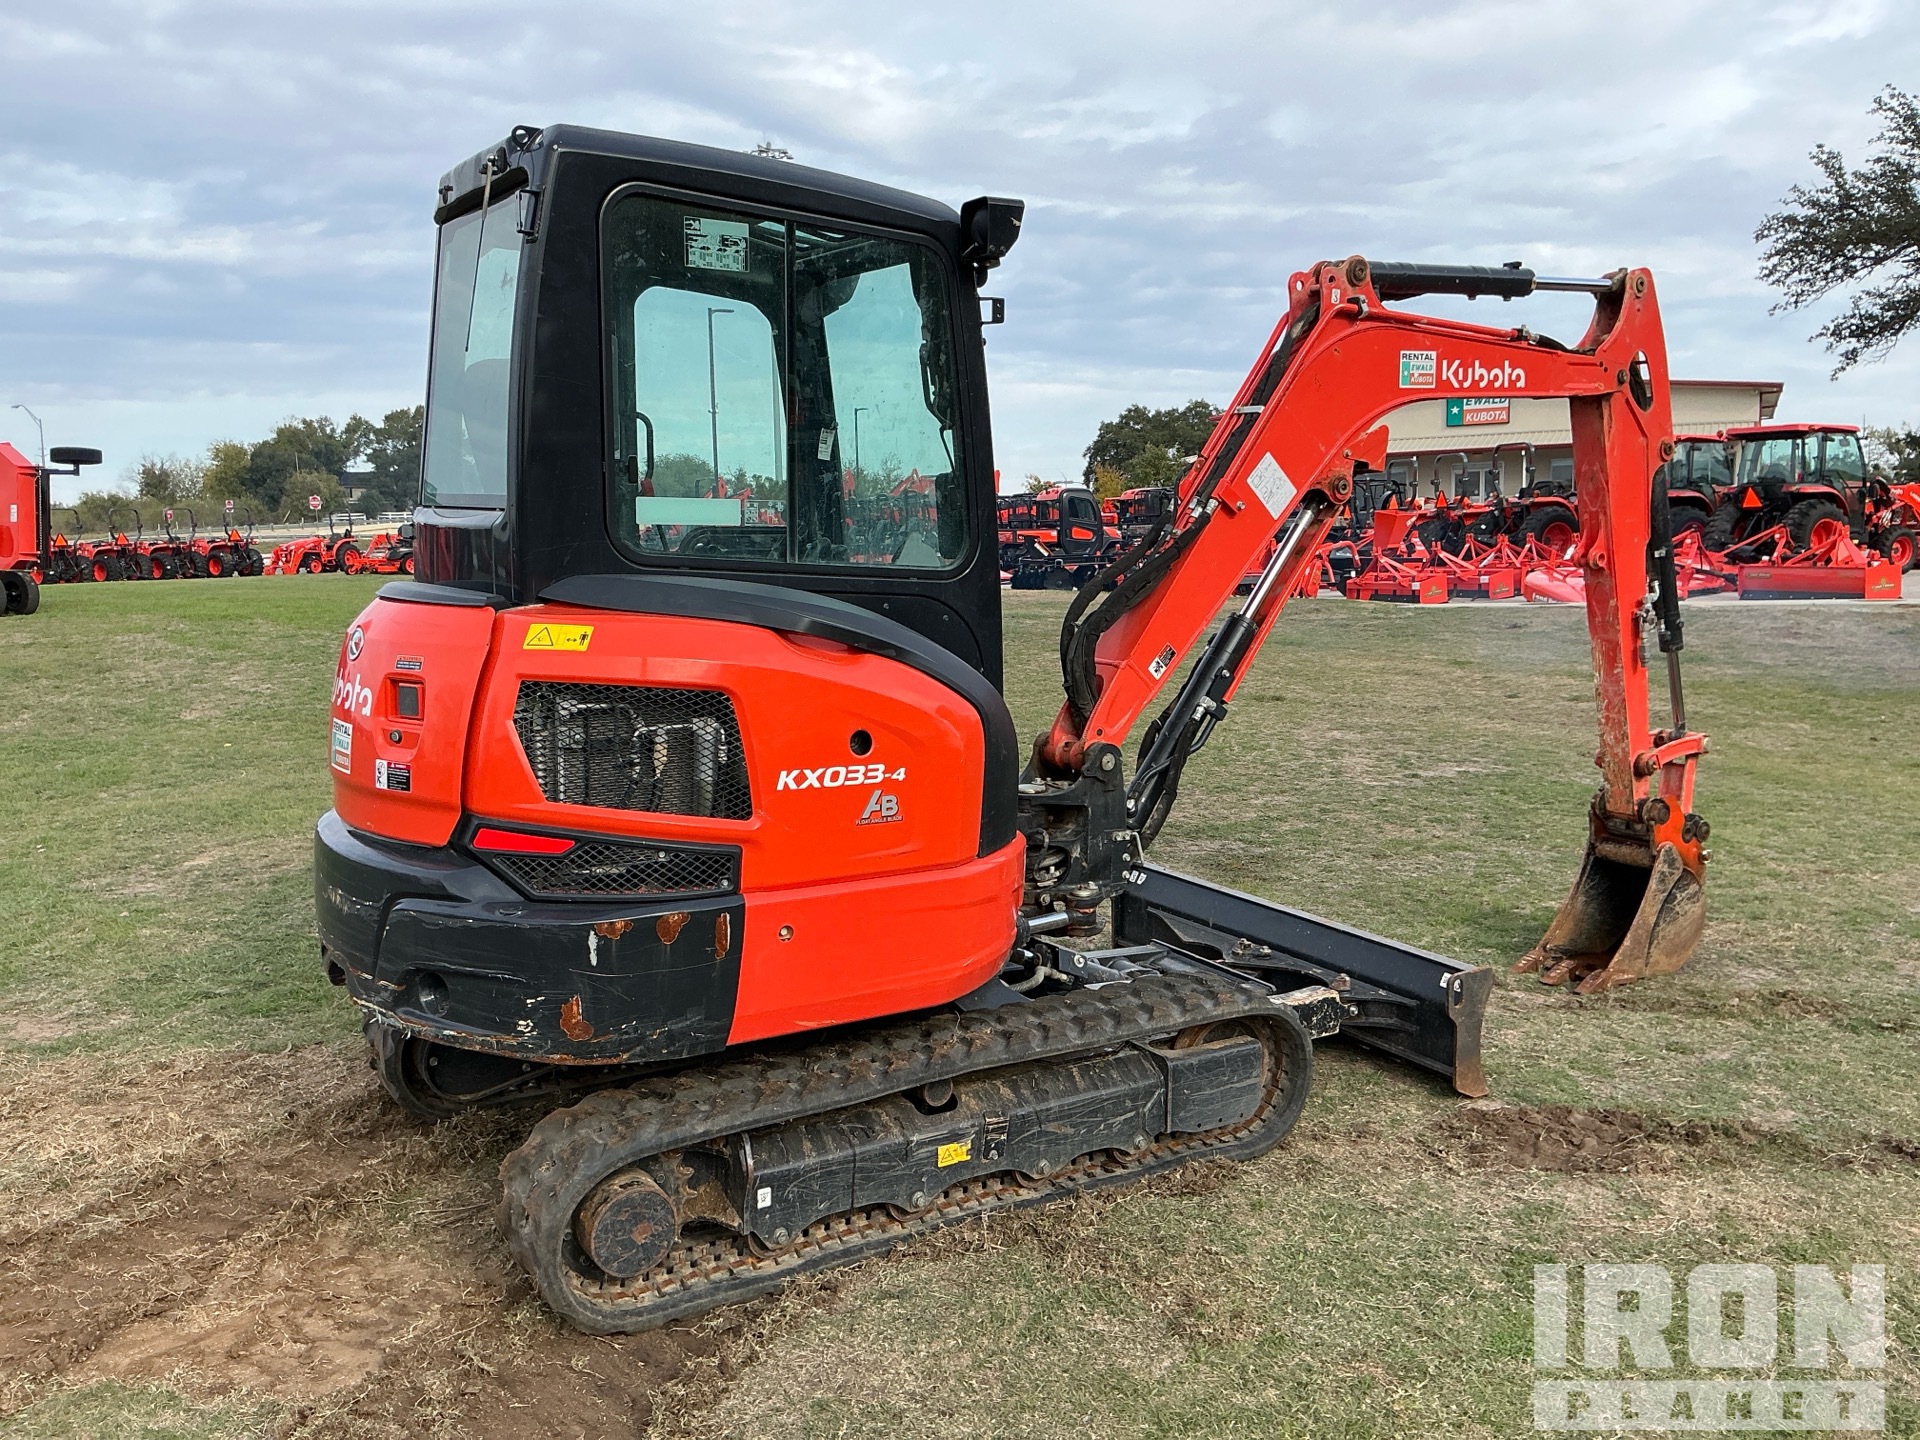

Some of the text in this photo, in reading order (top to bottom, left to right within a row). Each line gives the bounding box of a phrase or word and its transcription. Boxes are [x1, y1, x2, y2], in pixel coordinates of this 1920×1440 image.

[1402, 353, 1434, 361] RENTAL
[1411, 364, 1433, 372] EWALD
[1442, 359, 1526, 388] Kubota
[1411, 375, 1432, 383] KUBOTA
[1466, 410, 1507, 422] KUBOTA
[331, 667, 373, 717] ubota
[776, 763, 907, 791] KX033-4
